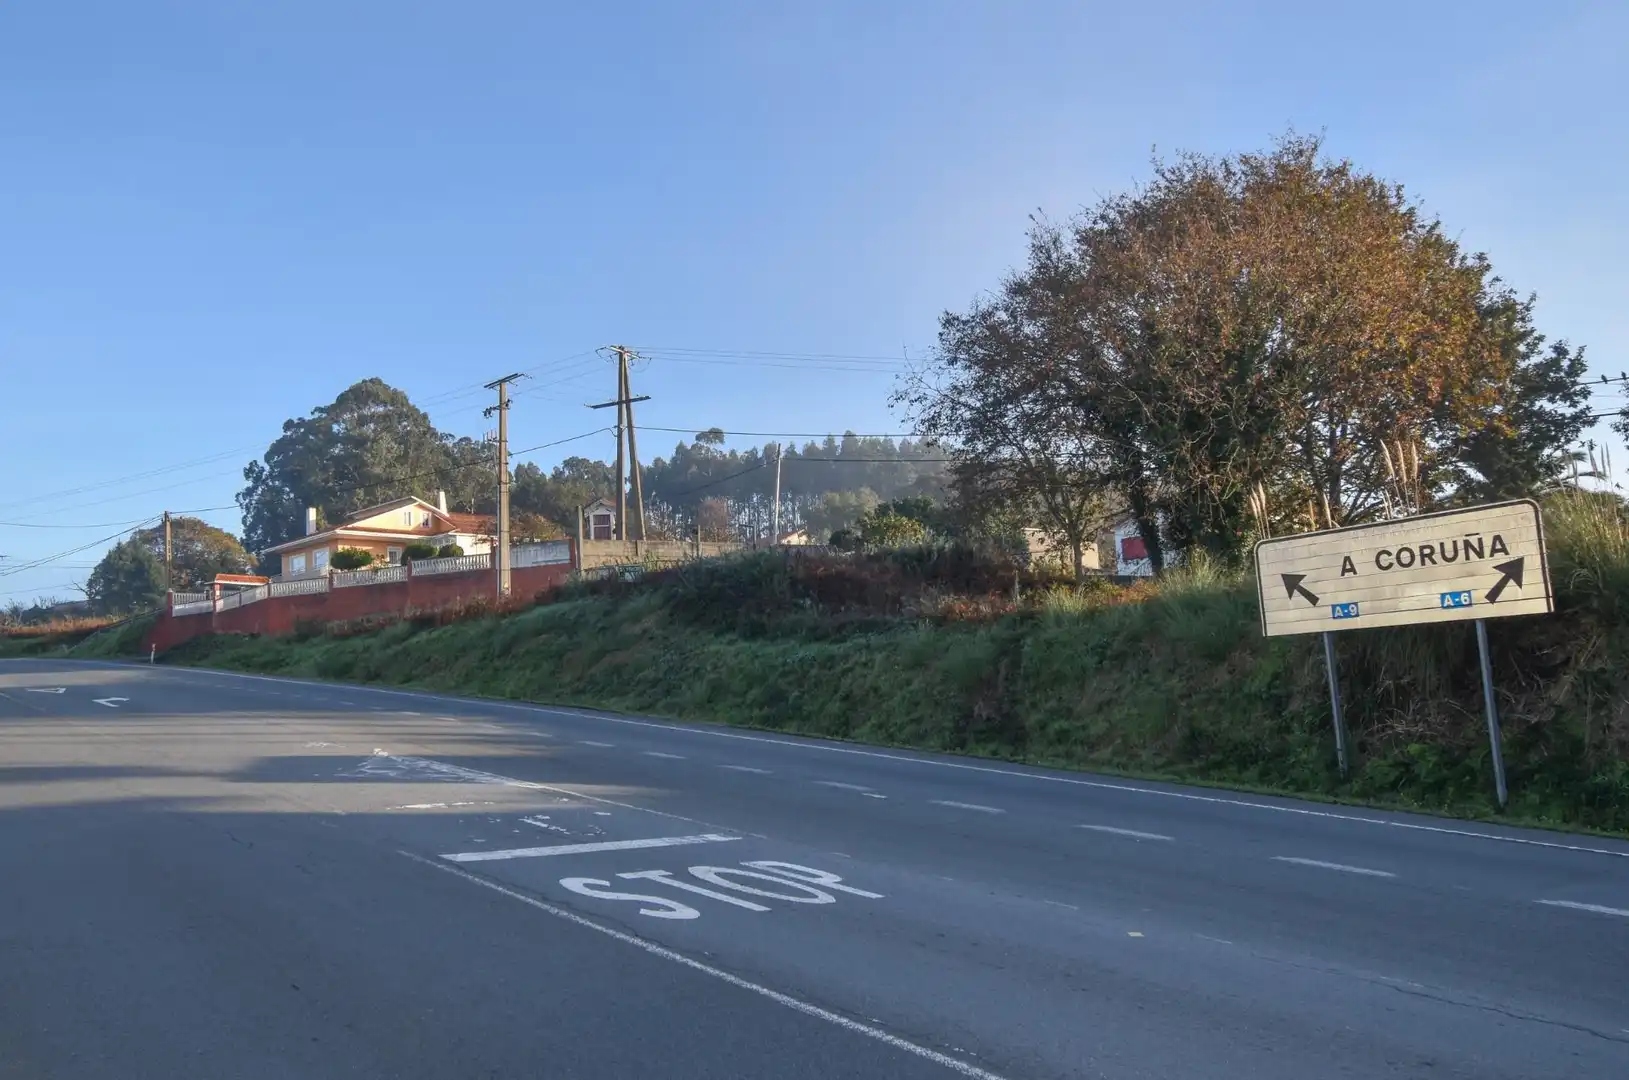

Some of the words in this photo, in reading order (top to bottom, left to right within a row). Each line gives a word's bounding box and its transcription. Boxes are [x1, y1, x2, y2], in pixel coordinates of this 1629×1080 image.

[1340, 555, 1358, 576] A
[1374, 533, 1510, 571] CORUÑA
[1333, 603, 1359, 618] A-9
[1442, 592, 1471, 607] A-6
[559, 860, 886, 920] STOP
